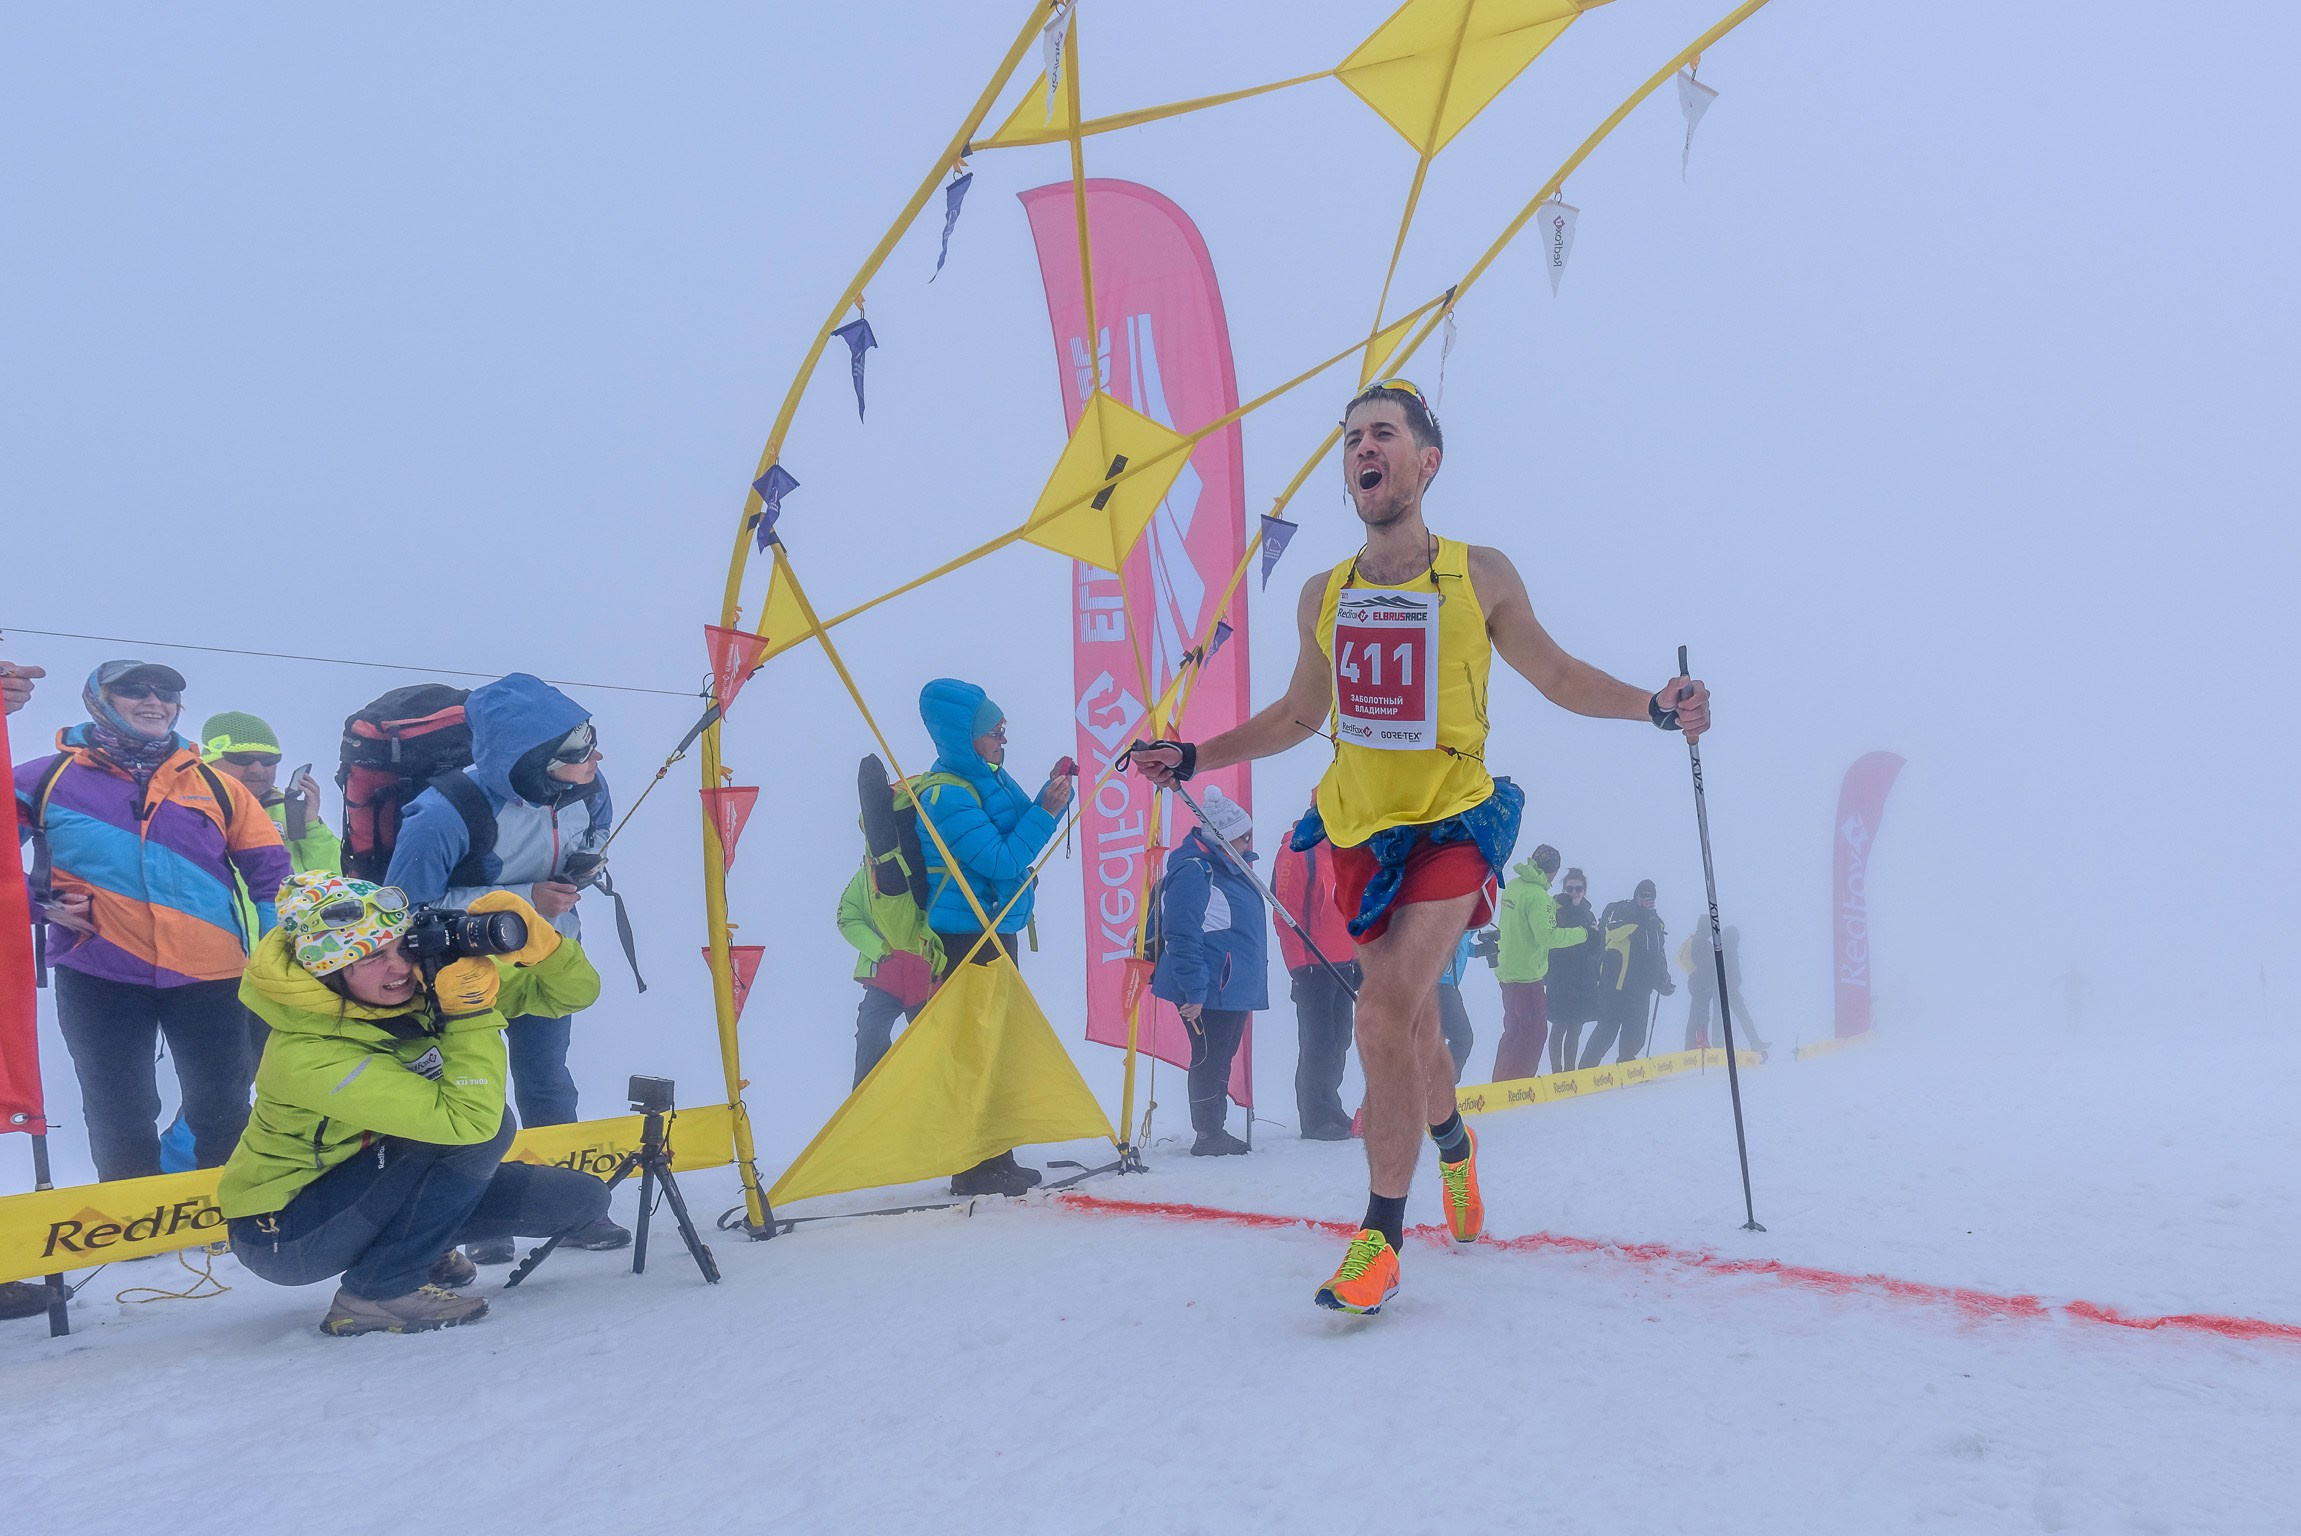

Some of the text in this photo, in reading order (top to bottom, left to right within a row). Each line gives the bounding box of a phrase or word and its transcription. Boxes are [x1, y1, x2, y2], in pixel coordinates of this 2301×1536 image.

[1373, 612, 1428, 621] ELBRUSRACE
[1340, 641, 1413, 686] 411
[1351, 693, 1404, 705] ЗАБОЛОТНЫЙ
[1354, 704, 1399, 715] ВЛАДИМИР
[1342, 721, 1363, 735] RedFox
[1840, 853, 1867, 988] RedFox
[1507, 1089, 1530, 1103] RedFox
[1457, 1097, 1478, 1112] edFox
[40, 1200, 228, 1258] RedFo
